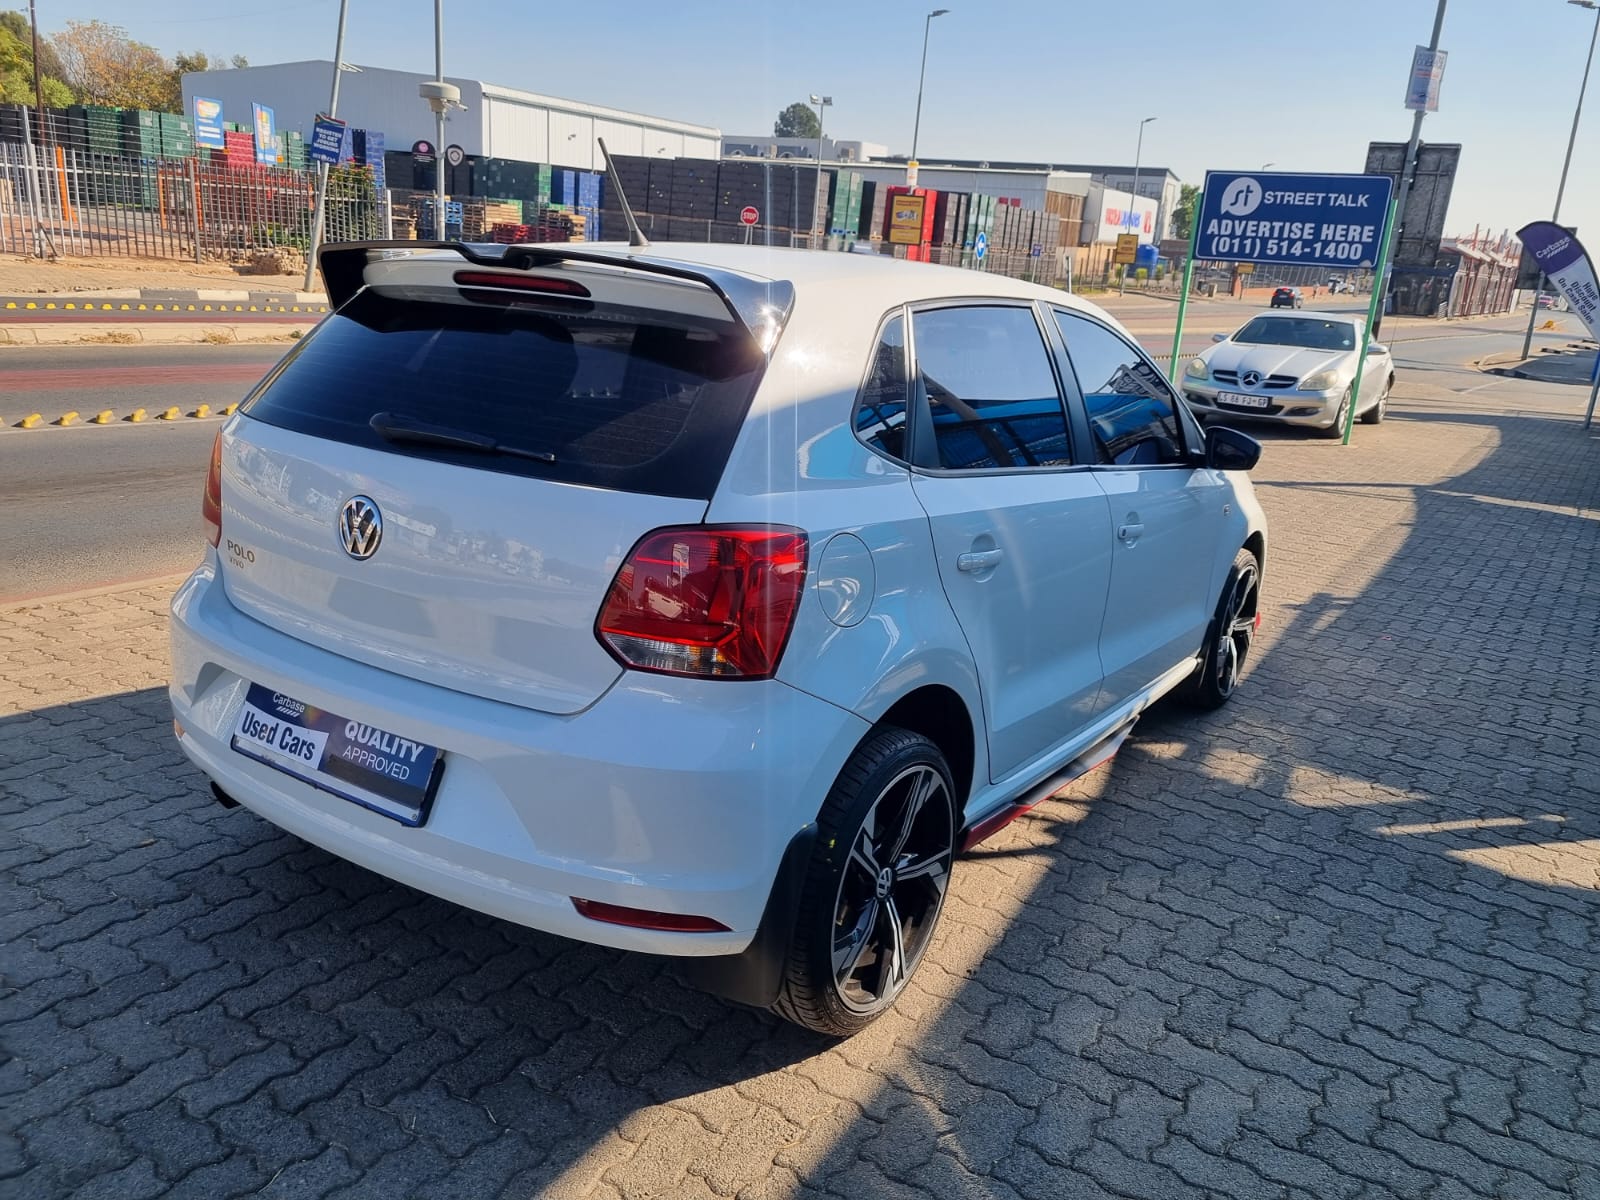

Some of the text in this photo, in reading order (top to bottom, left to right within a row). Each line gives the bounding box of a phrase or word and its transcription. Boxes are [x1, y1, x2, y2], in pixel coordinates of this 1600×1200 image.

[1264, 191, 1326, 206] STREET
[1328, 193, 1370, 208] TALK
[743, 211, 757, 220] STOP
[1207, 219, 1375, 243] ADVERTISE HERE
[1211, 236, 1363, 260] (011) 514-1400
[1535, 236, 1571, 258] Carbase
[1558, 277, 1595, 325] On Cash Sales
[1570, 281, 1597, 312] Discount
[227, 539, 255, 563] POLO
[230, 557, 245, 569] VIVO
[273, 692, 305, 713] Carbase
[241, 711, 316, 761] Used Cars
[344, 720, 424, 763] QUALITY
[342, 745, 410, 780] APPROVED
